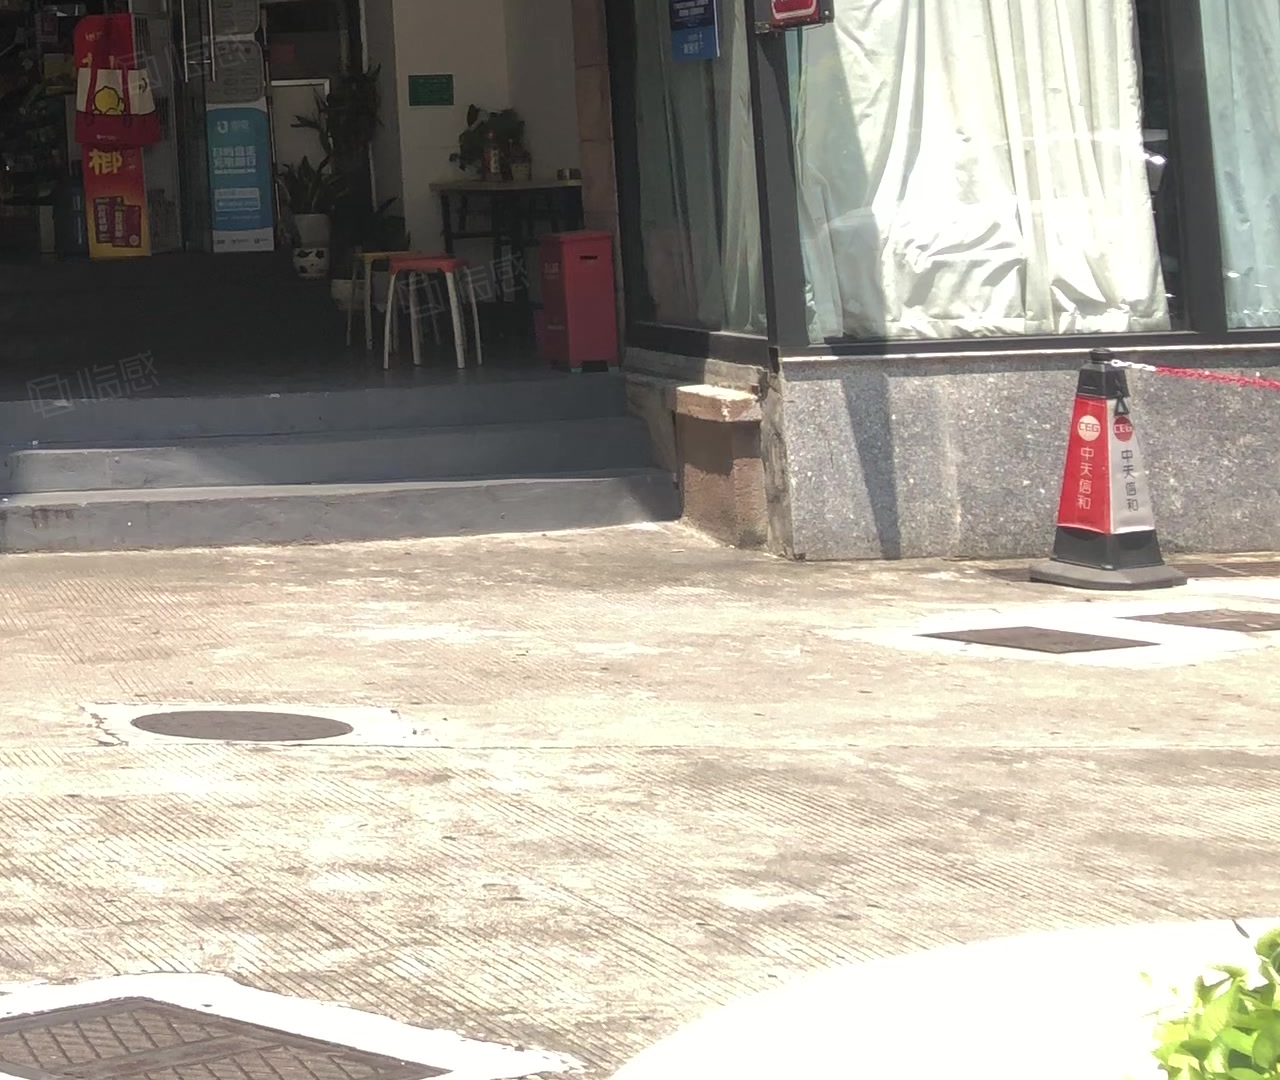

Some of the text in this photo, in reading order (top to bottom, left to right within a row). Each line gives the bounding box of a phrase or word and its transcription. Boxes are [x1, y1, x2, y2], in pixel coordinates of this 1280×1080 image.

[1077, 446, 1095, 510] 中天信和
[1121, 449, 1139, 512] 中天信和
